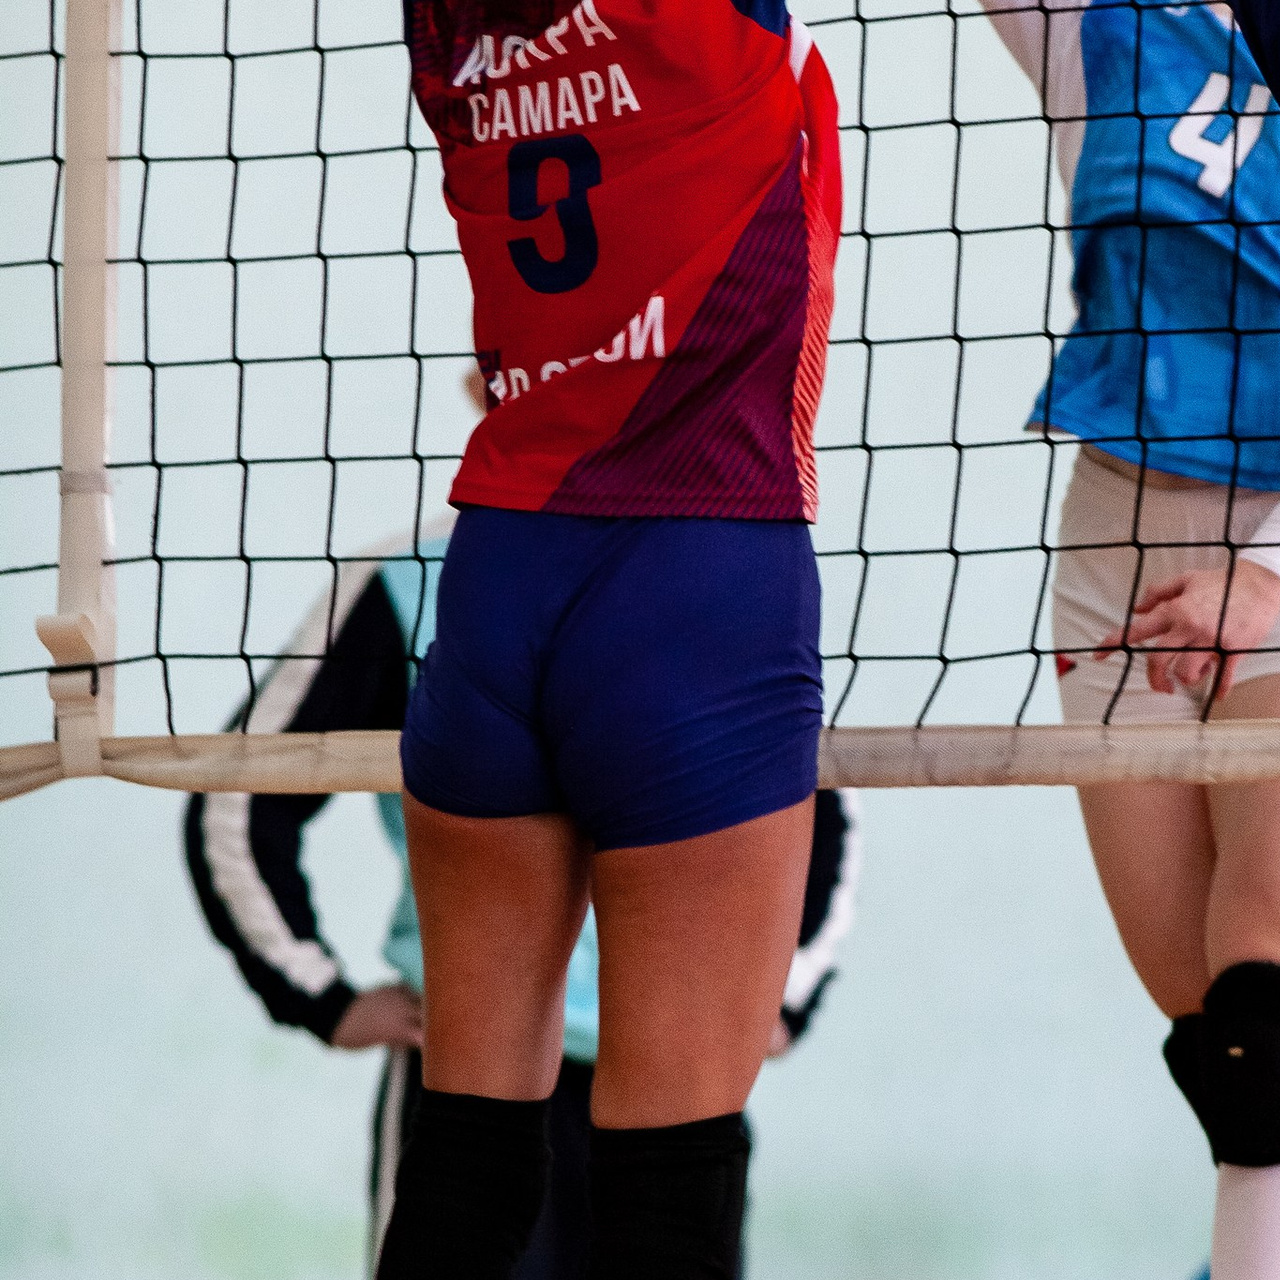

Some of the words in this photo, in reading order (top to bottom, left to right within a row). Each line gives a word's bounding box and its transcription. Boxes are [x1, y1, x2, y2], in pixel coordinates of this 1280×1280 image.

[467, 63, 642, 142] САМАРА
[1169, 72, 1272, 198] 4
[508, 133, 602, 294] 9
